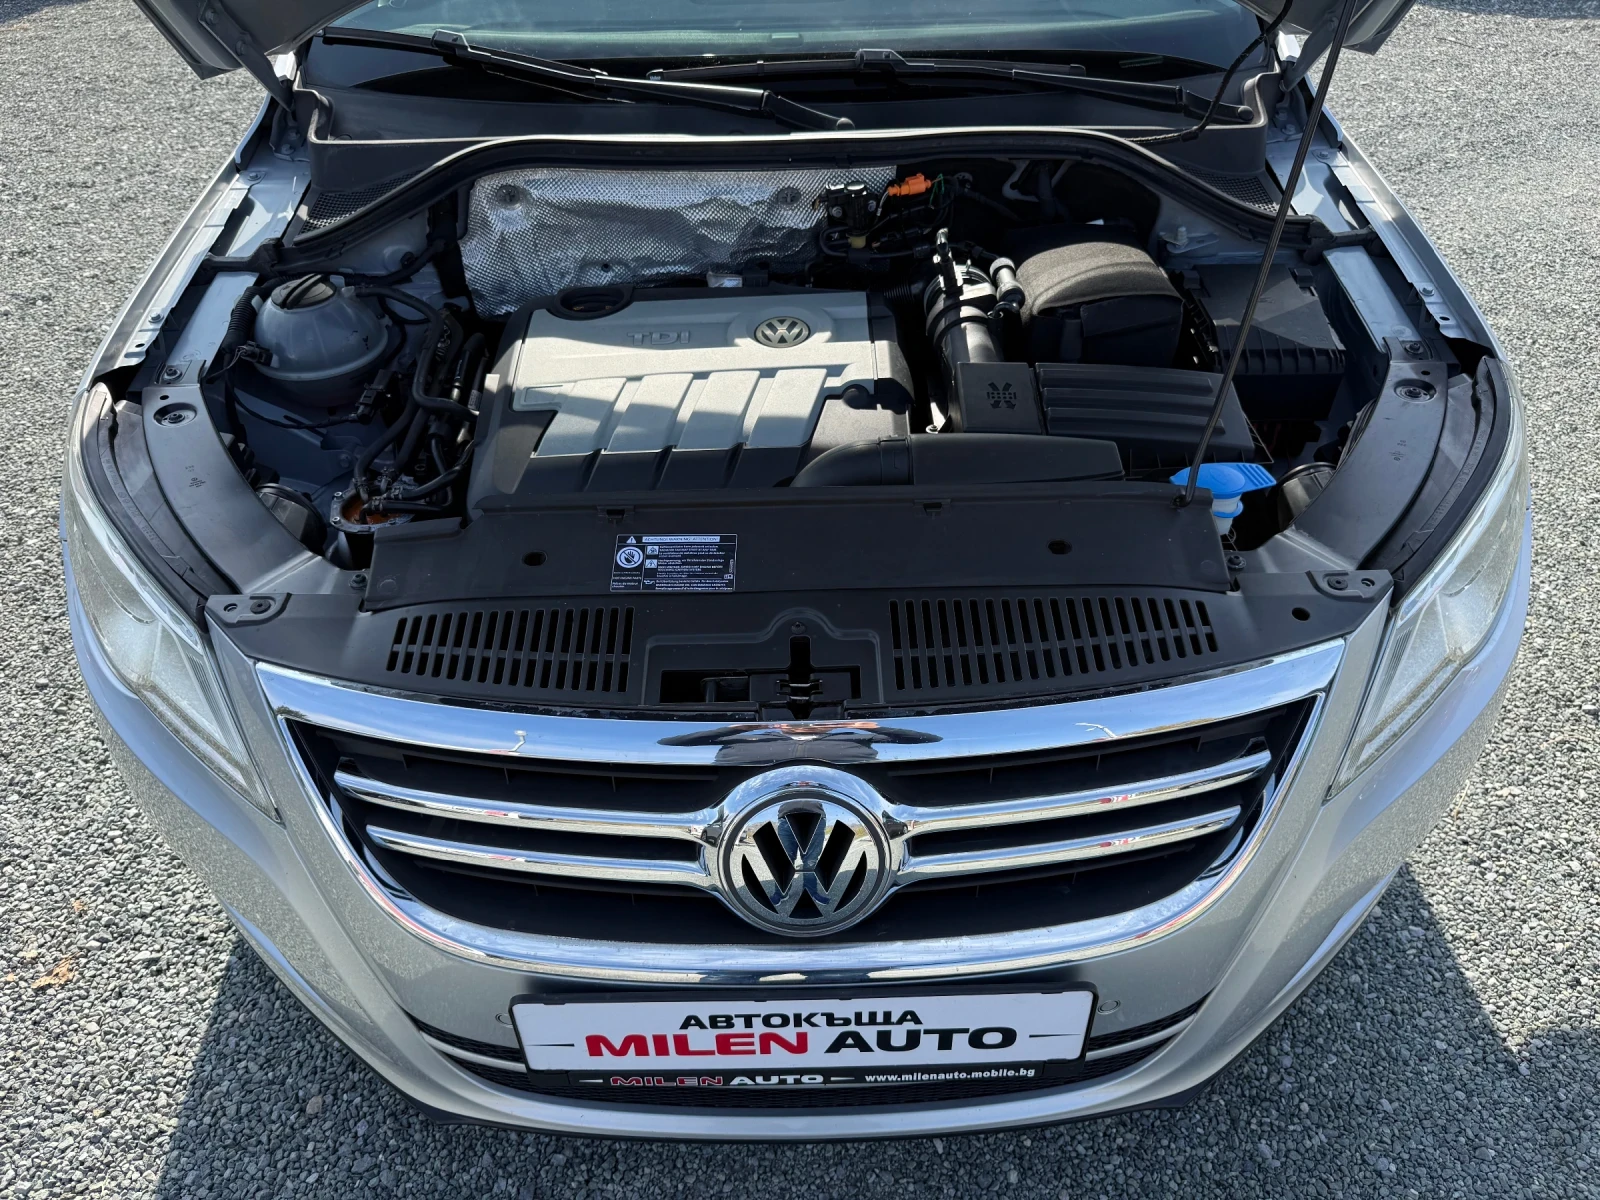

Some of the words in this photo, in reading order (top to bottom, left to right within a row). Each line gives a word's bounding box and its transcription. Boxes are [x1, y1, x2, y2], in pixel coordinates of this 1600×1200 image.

[627, 330, 690, 345] TDI
[585, 1031, 809, 1057] MILEN
[823, 1026, 1018, 1054] AUTO
[609, 1075, 723, 1087] MILEN
[729, 1073, 825, 1086] AUTO
[864, 1067, 1036, 1083] www.milenauto.mobile.bg
